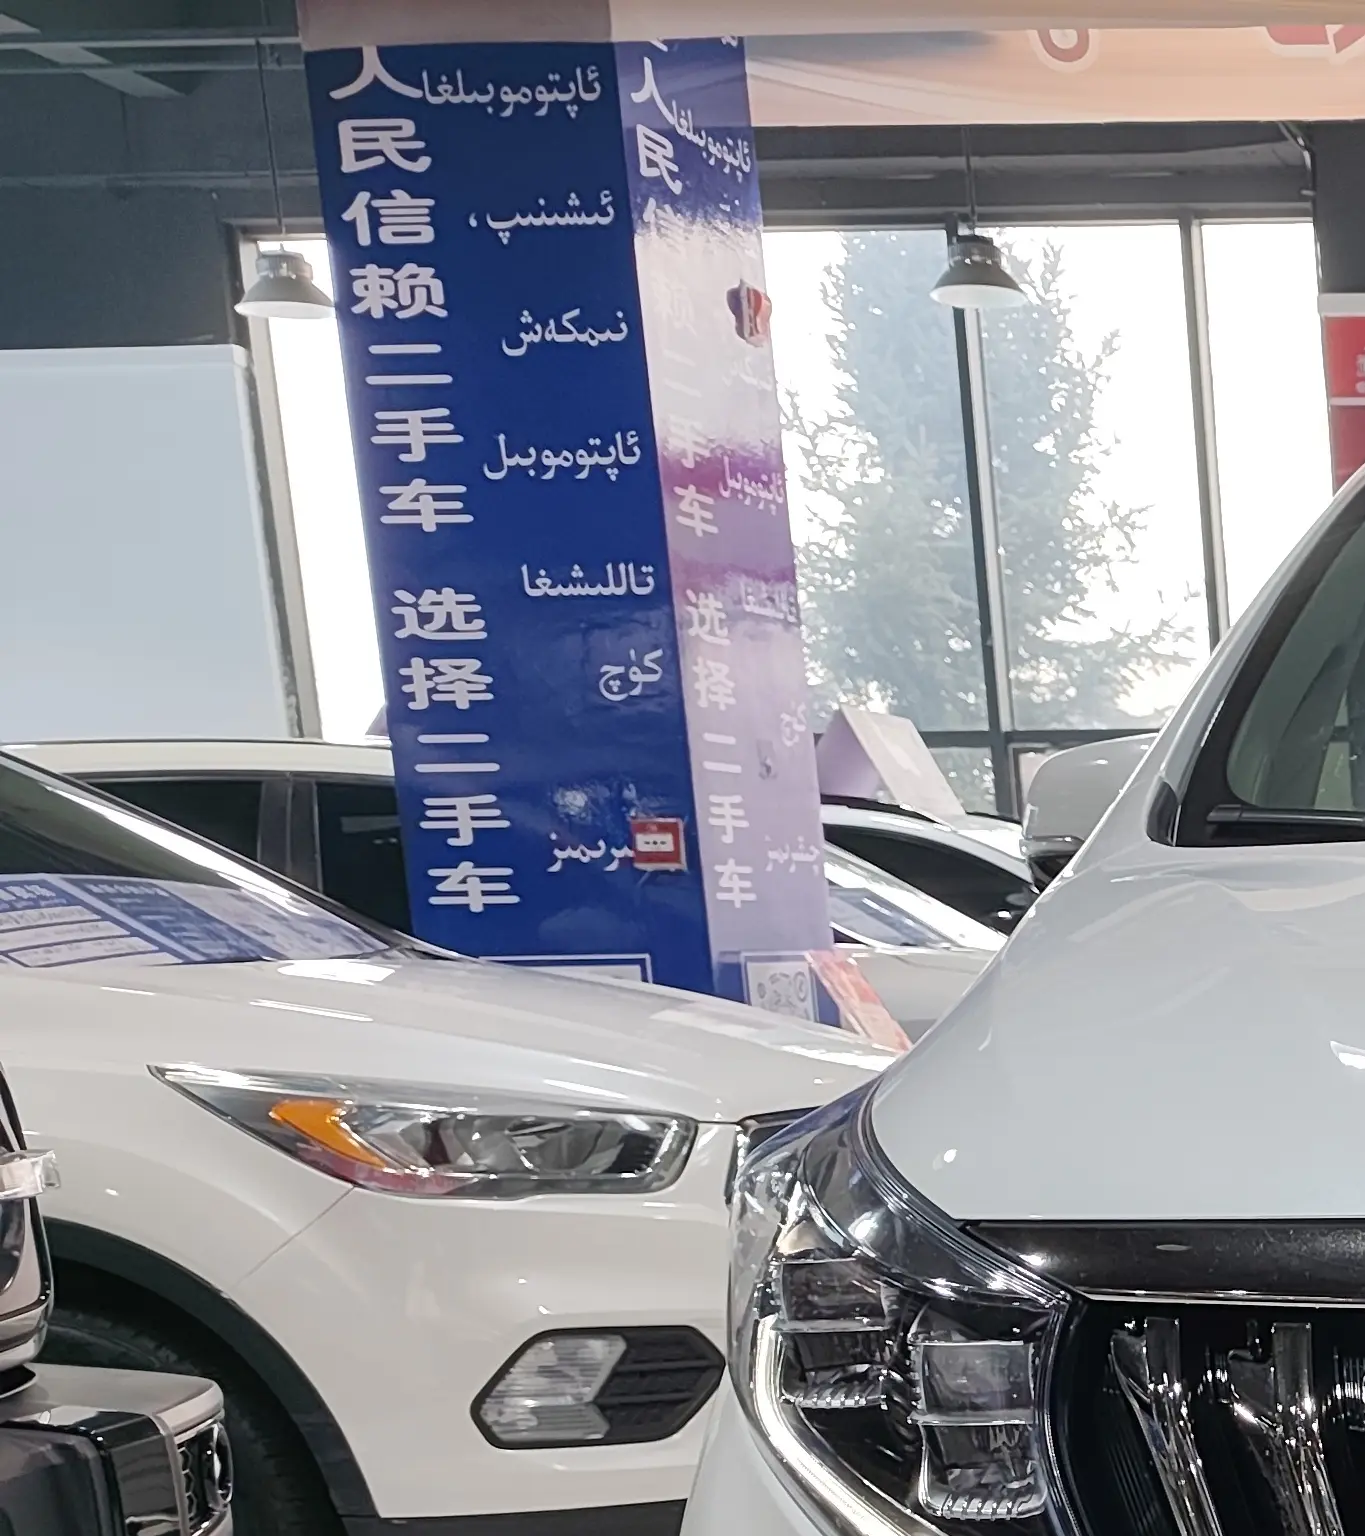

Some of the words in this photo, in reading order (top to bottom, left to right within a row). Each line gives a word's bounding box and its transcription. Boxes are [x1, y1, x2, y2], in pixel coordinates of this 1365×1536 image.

[329, 46, 476, 532] 人民信赖二手车
[391, 588, 520, 912] 选择二手车
